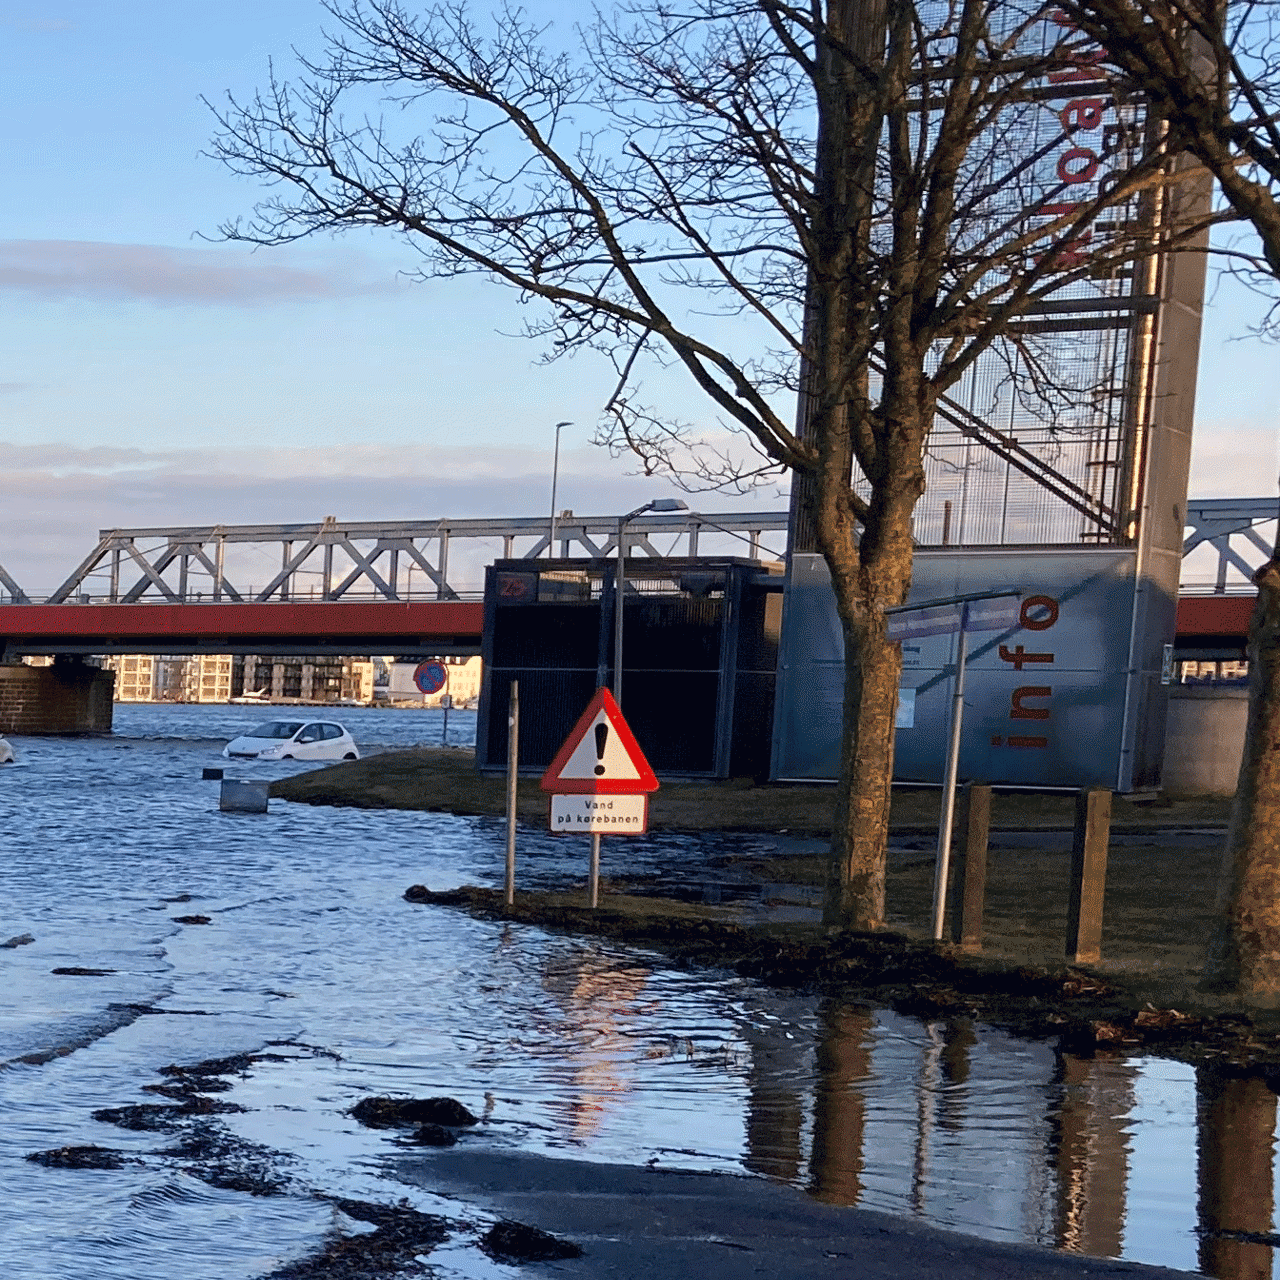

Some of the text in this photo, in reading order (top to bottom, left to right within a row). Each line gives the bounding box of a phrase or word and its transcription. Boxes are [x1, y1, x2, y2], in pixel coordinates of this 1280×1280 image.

[991, 595, 1060, 749] info
[584, 800, 614, 810] Vand
[557, 814, 639, 825] på kørebanen
